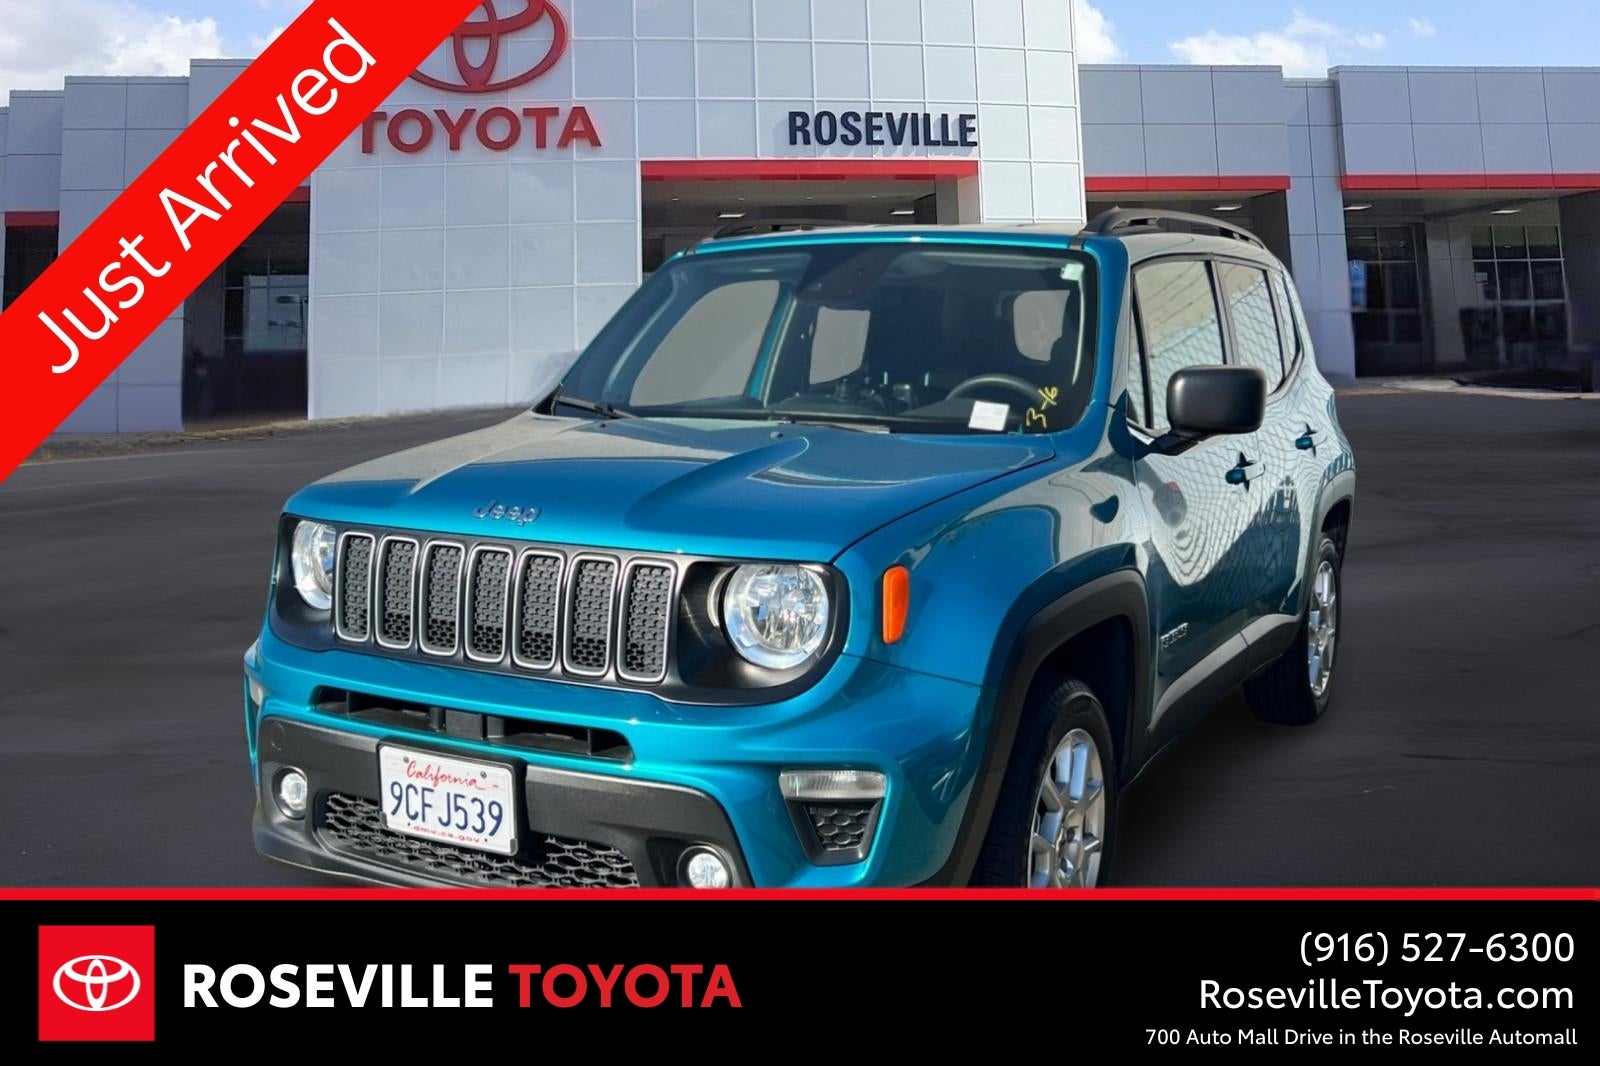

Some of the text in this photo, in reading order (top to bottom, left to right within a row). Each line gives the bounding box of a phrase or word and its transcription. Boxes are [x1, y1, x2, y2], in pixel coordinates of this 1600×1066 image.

[361, 107, 602, 154] TOYOTA
[788, 111, 978, 147] ROSEVILLE
[473, 500, 540, 527] Jeep
[406, 760, 488, 791] California
[390, 781, 504, 837] 9CFJ539
